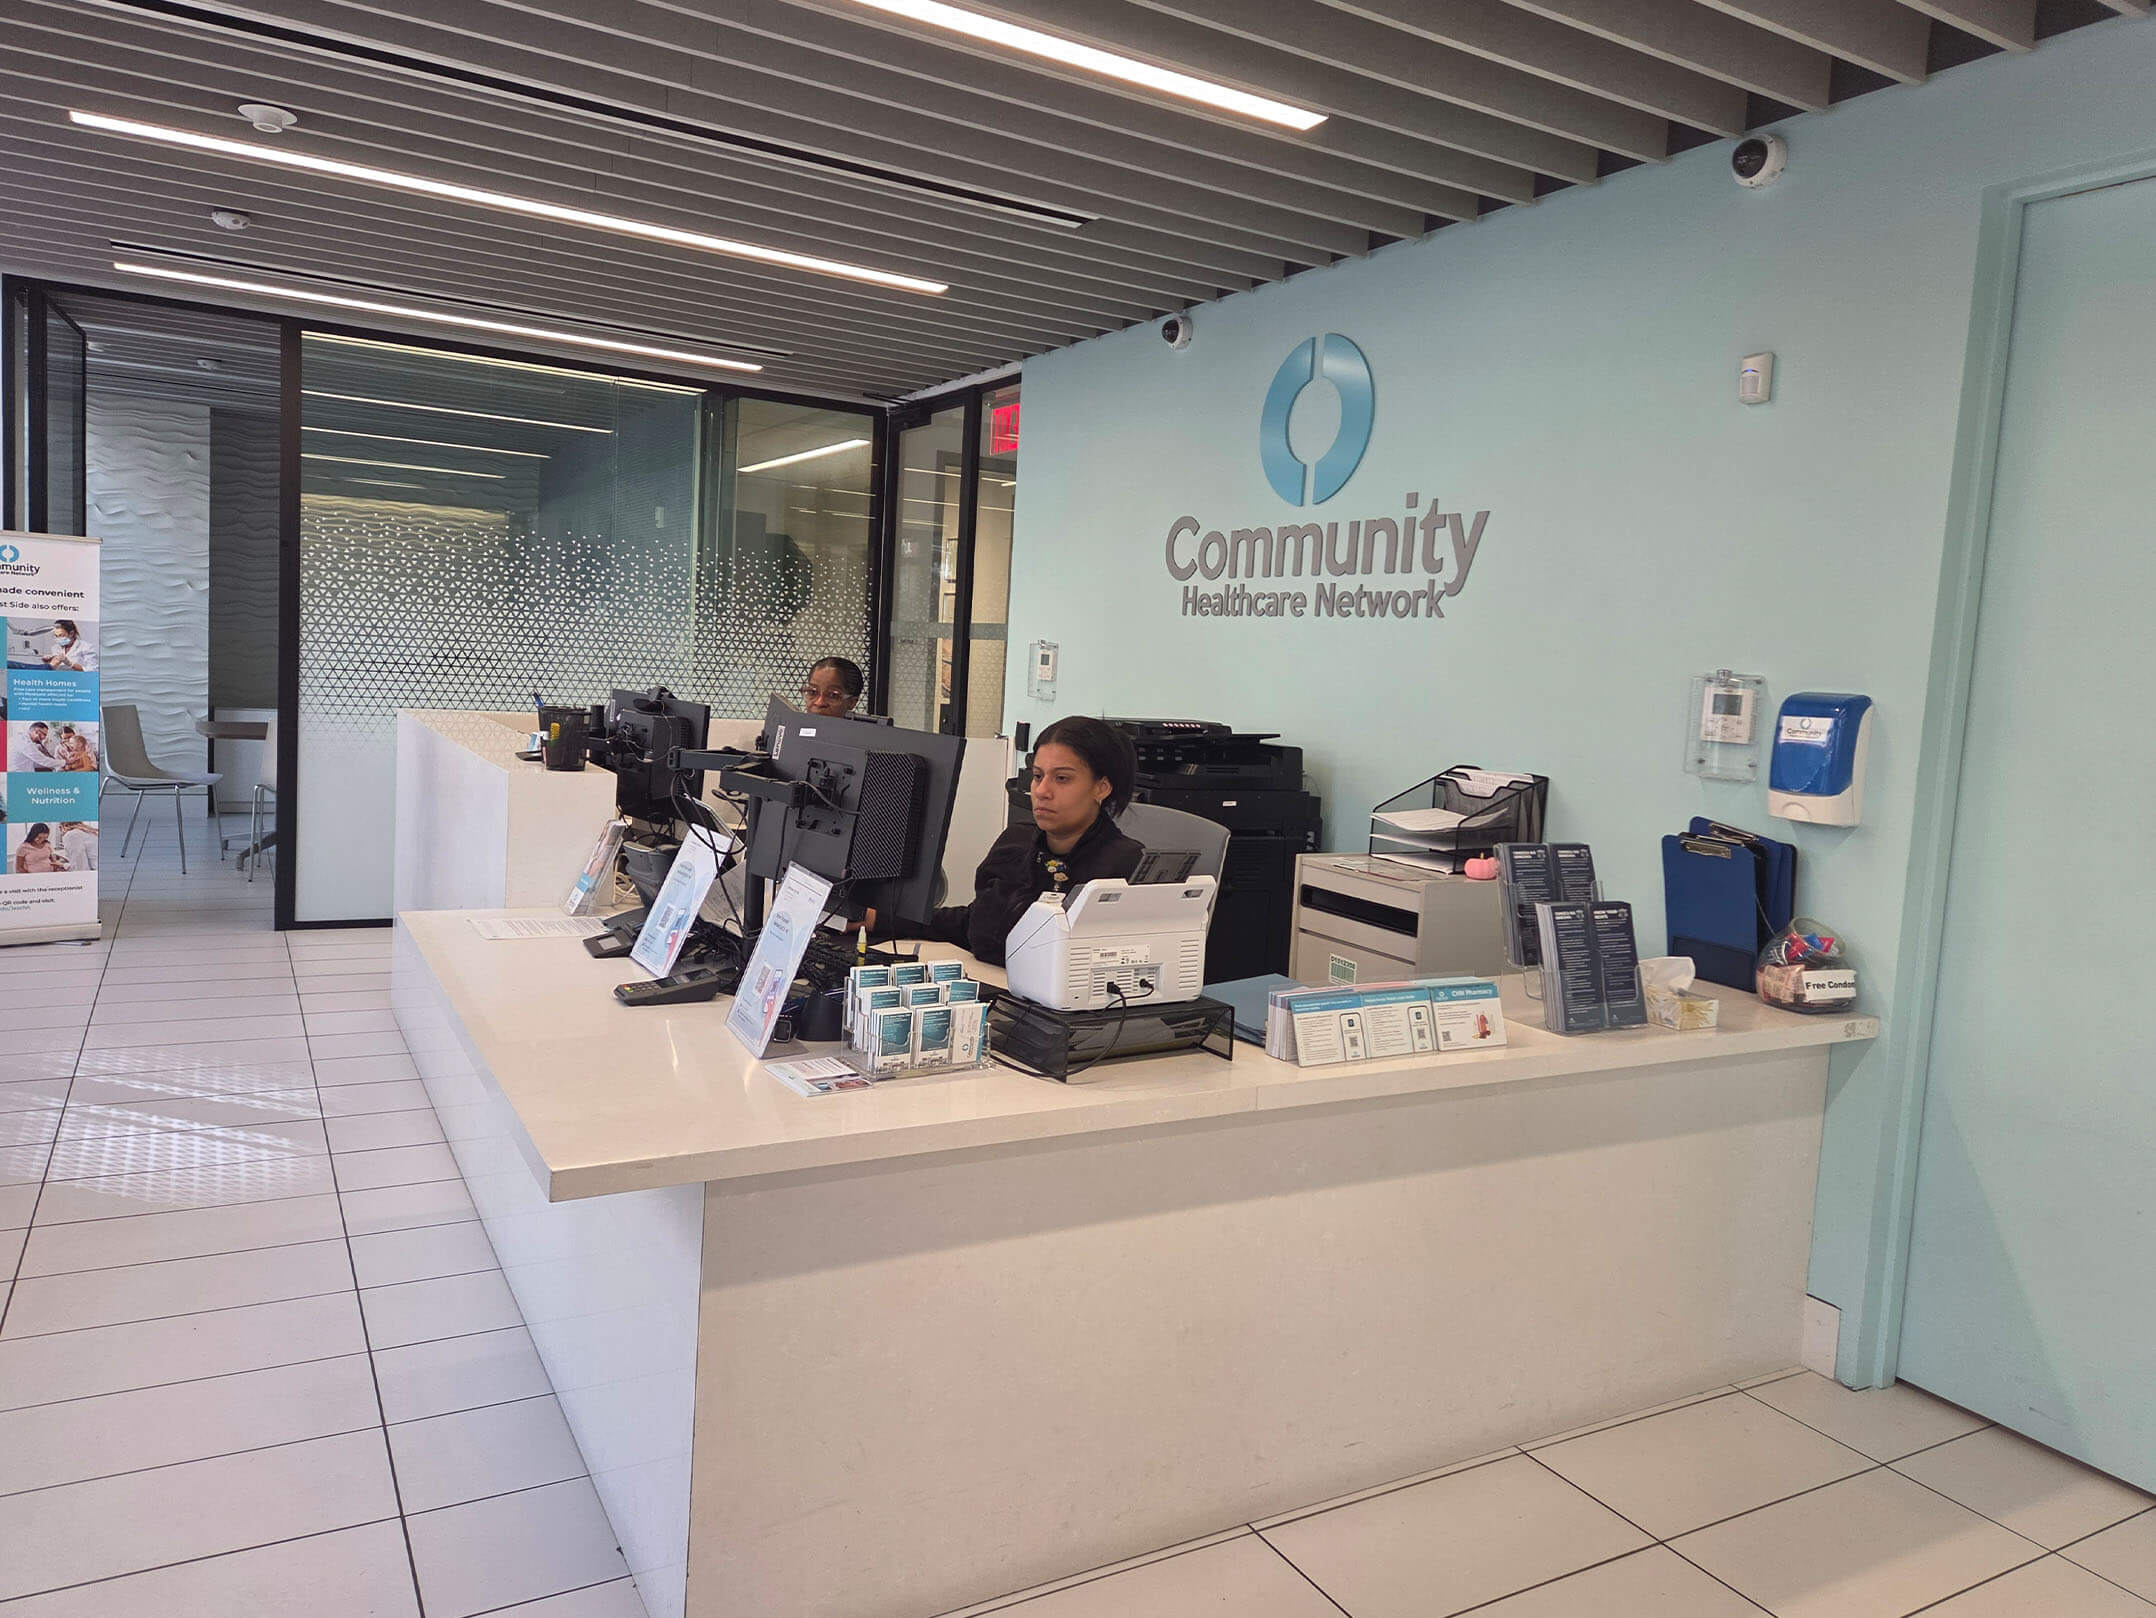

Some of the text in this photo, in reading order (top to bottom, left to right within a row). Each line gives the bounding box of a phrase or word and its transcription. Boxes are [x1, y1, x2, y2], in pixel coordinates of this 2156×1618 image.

[1165, 492, 1490, 597] Community
[0, 563, 40, 575] munity
[25, 589, 85, 598] convenient
[1181, 579, 1445, 618] Healthcare Network
[9, 601, 30, 609] Side
[32, 602, 50, 610] also
[51, 604, 80, 612] offers:
[14, 679, 44, 687] Health
[27, 787, 80, 795] Wellness &
[32, 797, 76, 805] Nutrition
[1805, 981, 1826, 990] Free
